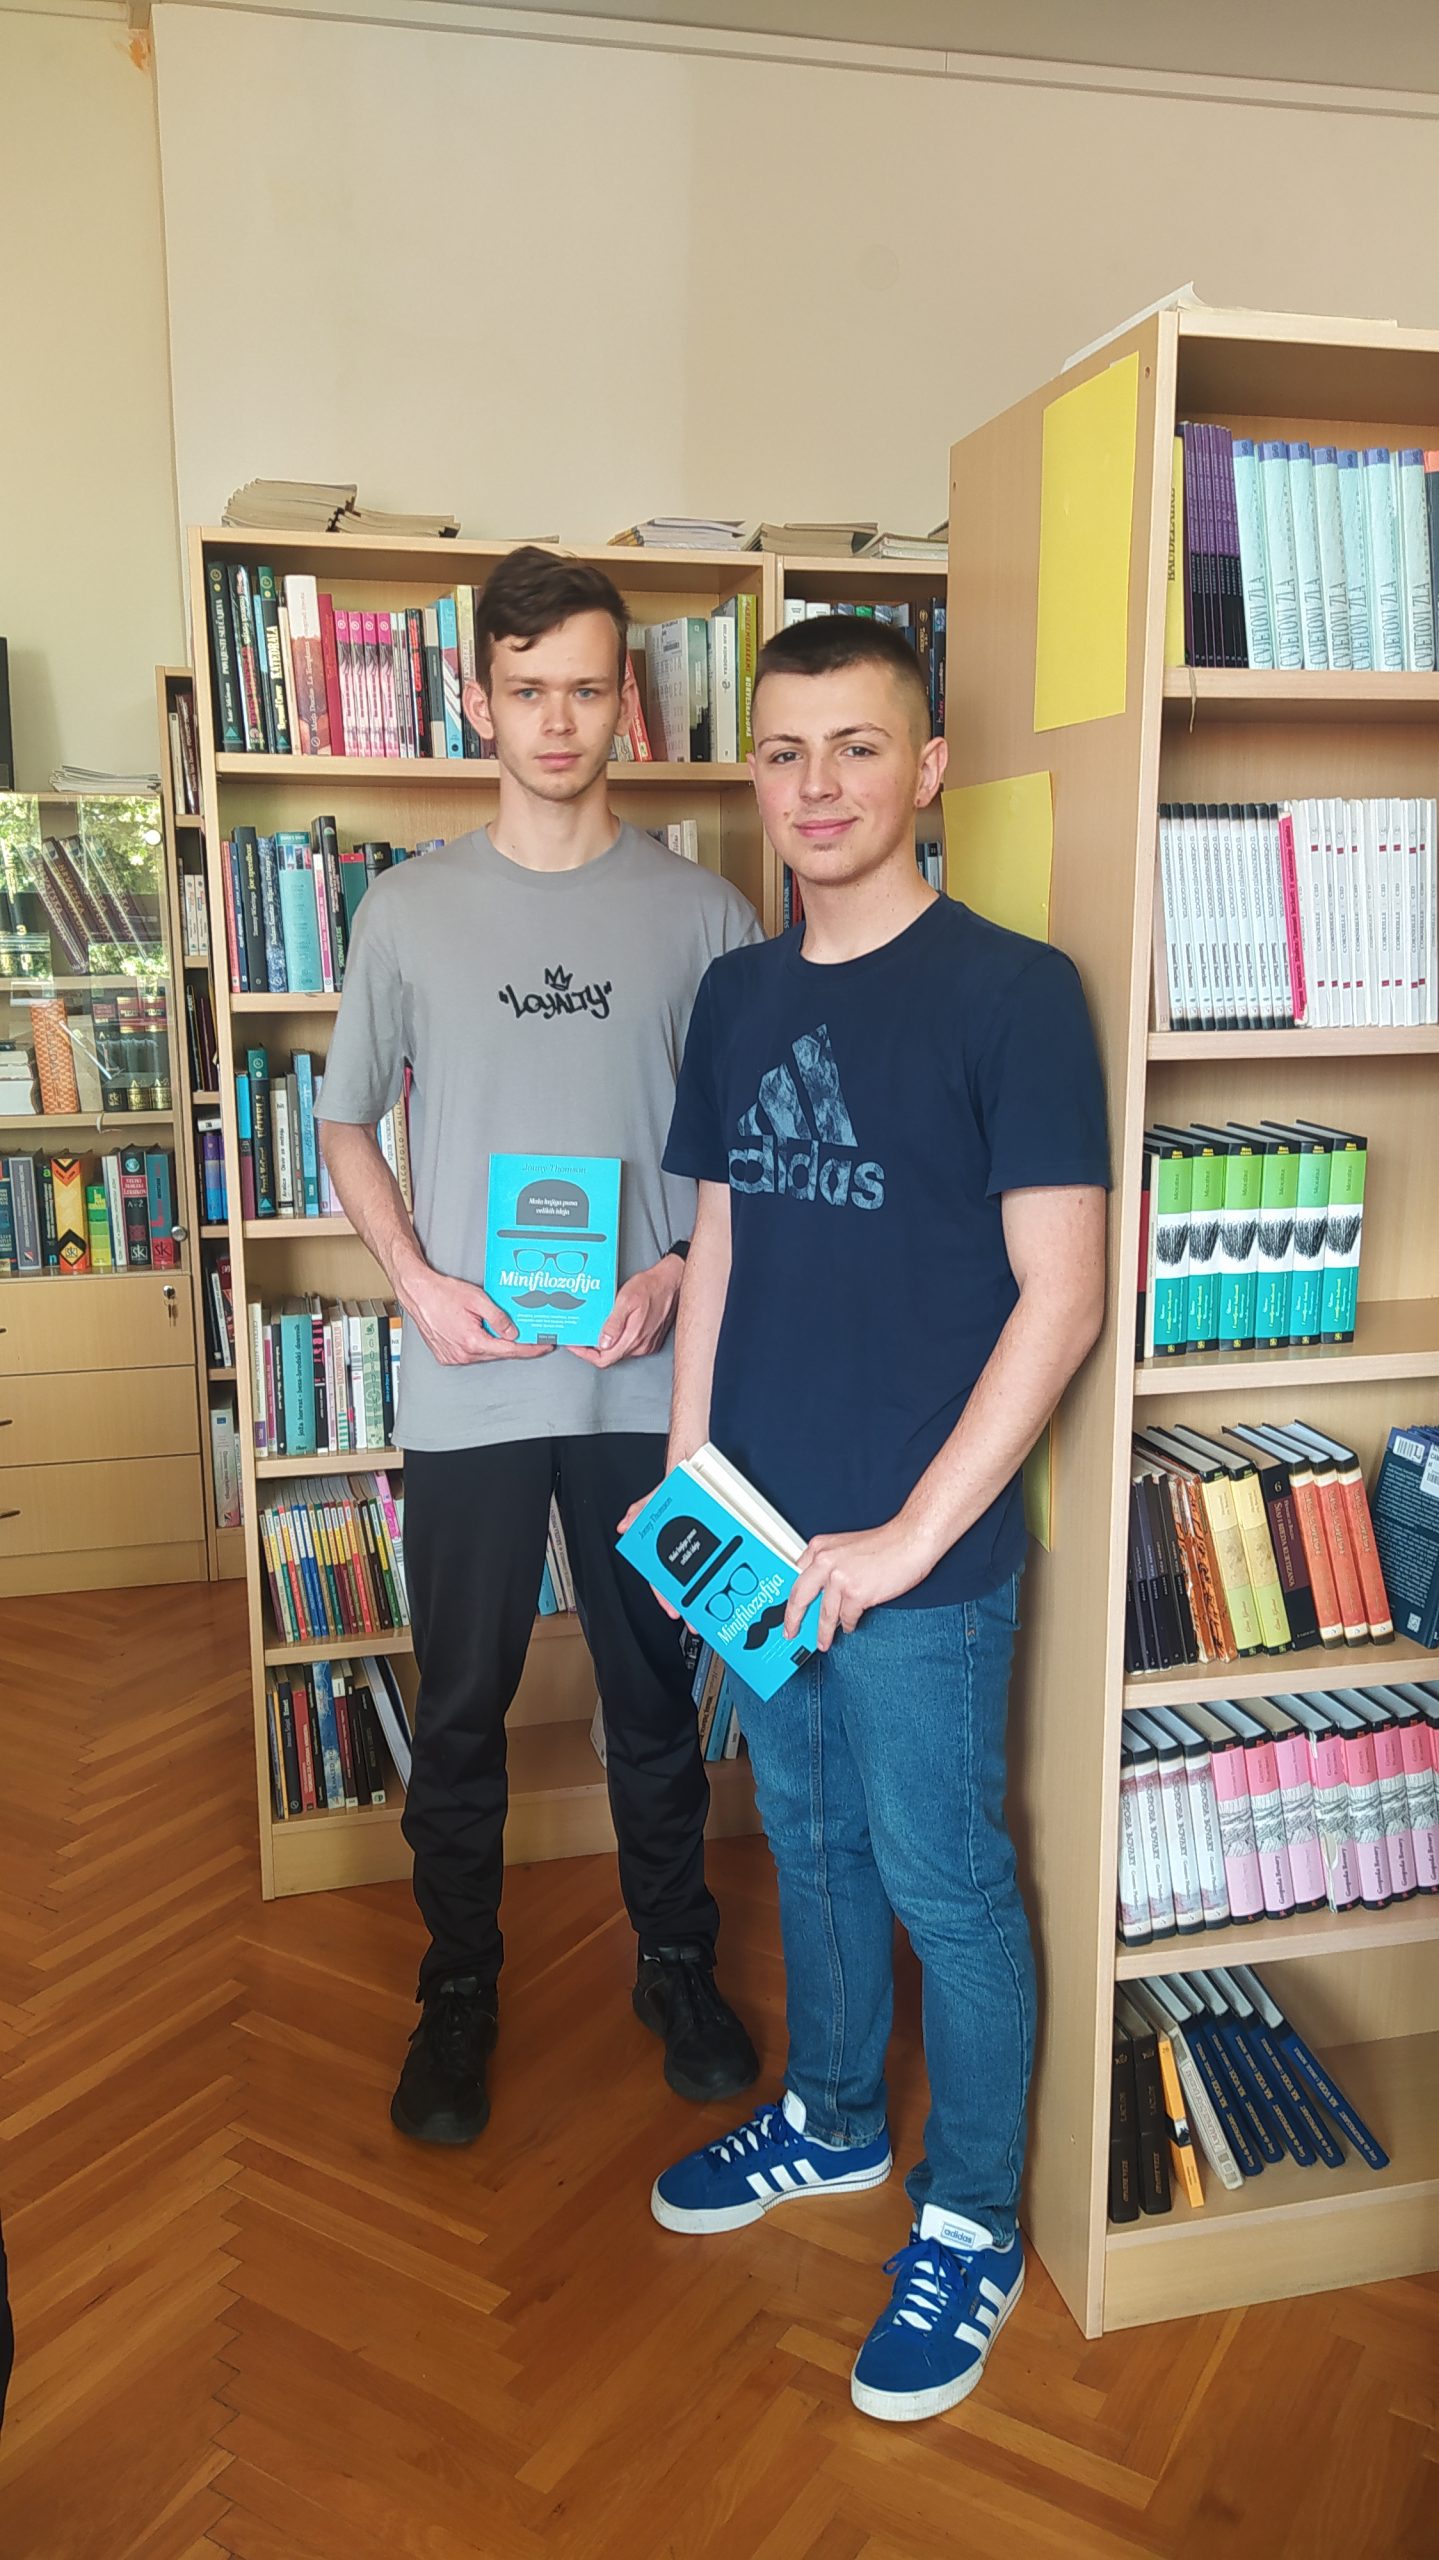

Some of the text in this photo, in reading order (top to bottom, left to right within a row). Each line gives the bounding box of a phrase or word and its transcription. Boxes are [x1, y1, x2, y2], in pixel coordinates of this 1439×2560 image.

[1248, 576, 1272, 664] CVJETOVI ZLA
[1275, 578, 1301, 666] CVJETOVI ZLA
[1304, 578, 1328, 665] CVJETOVI ZLA
[1329, 582, 1352, 668] CVJETOVI ZLA
[1348, 585, 1366, 609] ZLA
[1380, 581, 1403, 666] CVJETOVI ZLA
[1412, 582, 1434, 668] CVJETOVI ZLA
[266, 625, 282, 680] KATEDRALA
[57, 862, 85, 915] HRVATSKA
[728, 1136, 886, 1210] adidas
[499, 1270, 601, 1293] Minifilozofija
[1274, 1481, 1282, 1492] 6
[717, 1572, 785, 1646] Minifilozofija
[944, 2228, 973, 2245] adidas
